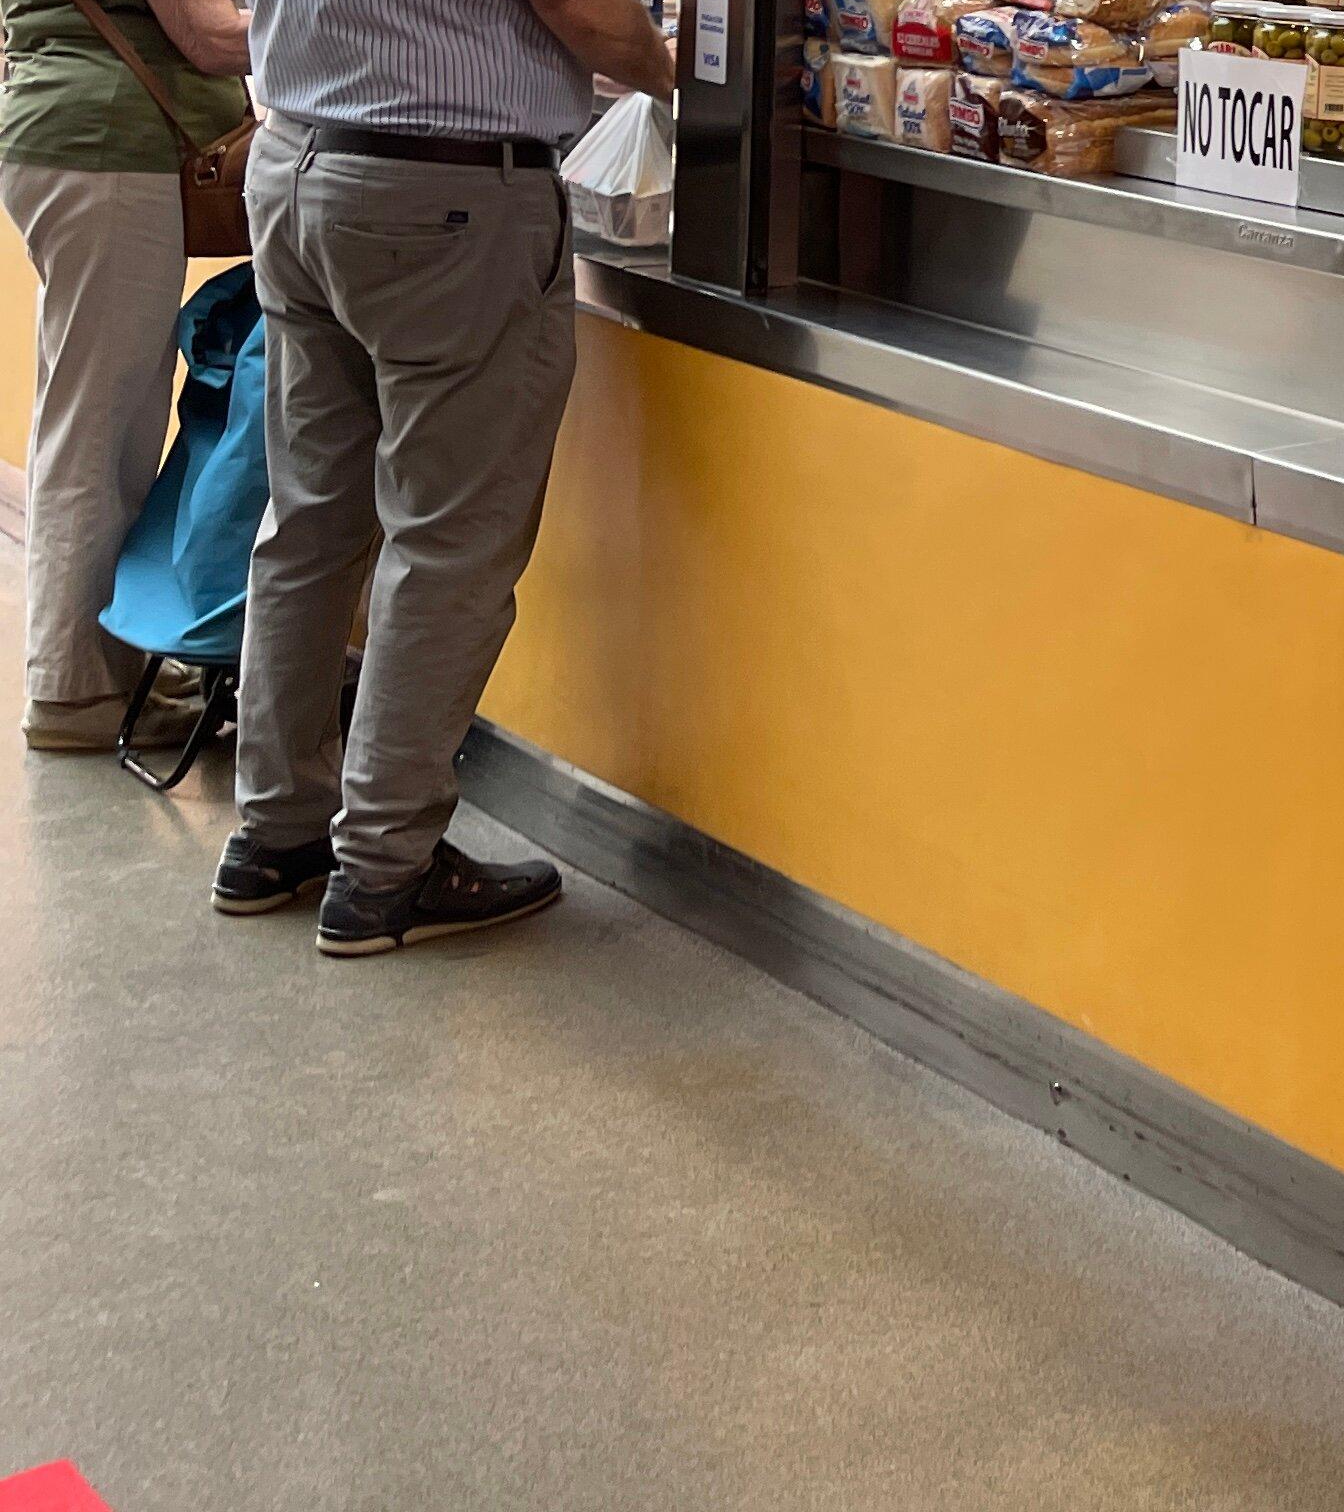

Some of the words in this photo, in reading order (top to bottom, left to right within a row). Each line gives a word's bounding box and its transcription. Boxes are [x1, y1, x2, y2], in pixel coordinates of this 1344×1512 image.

[703, 53, 720, 68] VISA
[1183, 80, 1213, 157] NO
[1217, 85, 1294, 171] TOCAR
